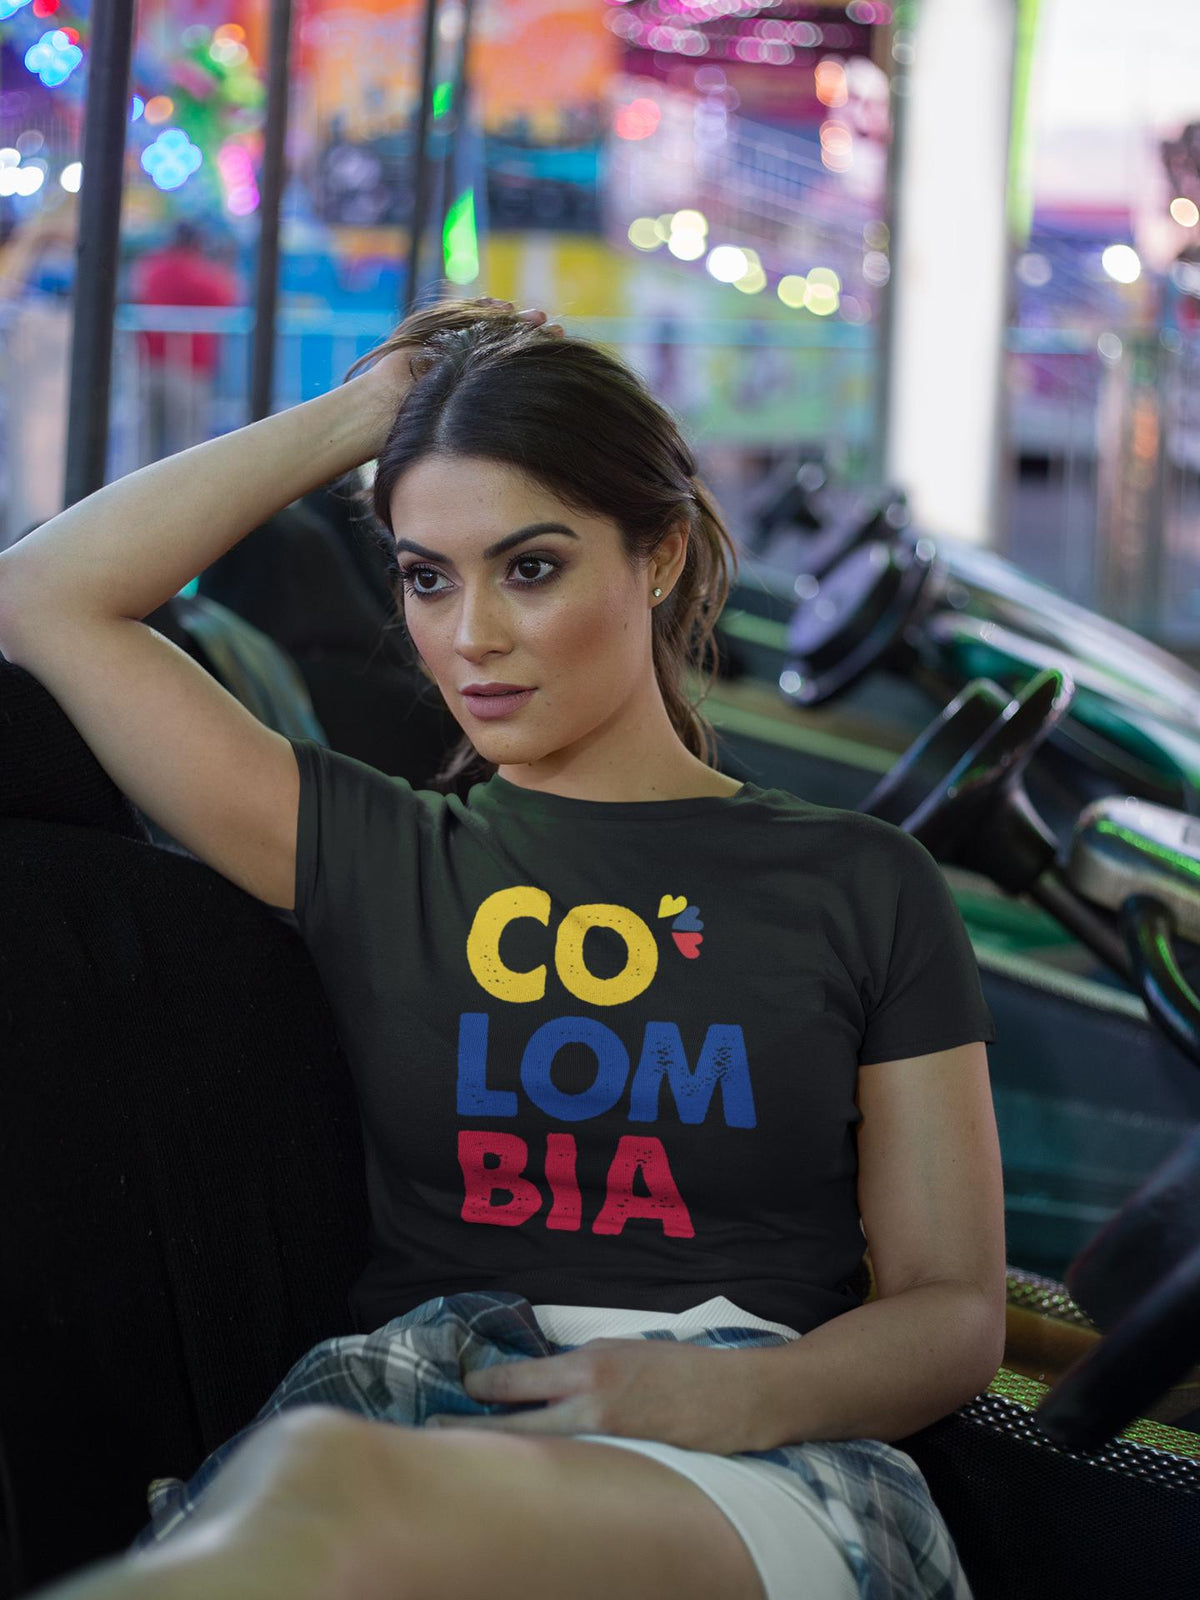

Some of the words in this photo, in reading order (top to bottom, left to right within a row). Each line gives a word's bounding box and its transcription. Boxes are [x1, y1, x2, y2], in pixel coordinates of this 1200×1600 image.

[467, 886, 658, 1006] CO
[456, 1012, 757, 1129] LOM
[457, 1130, 695, 1238] BIA
